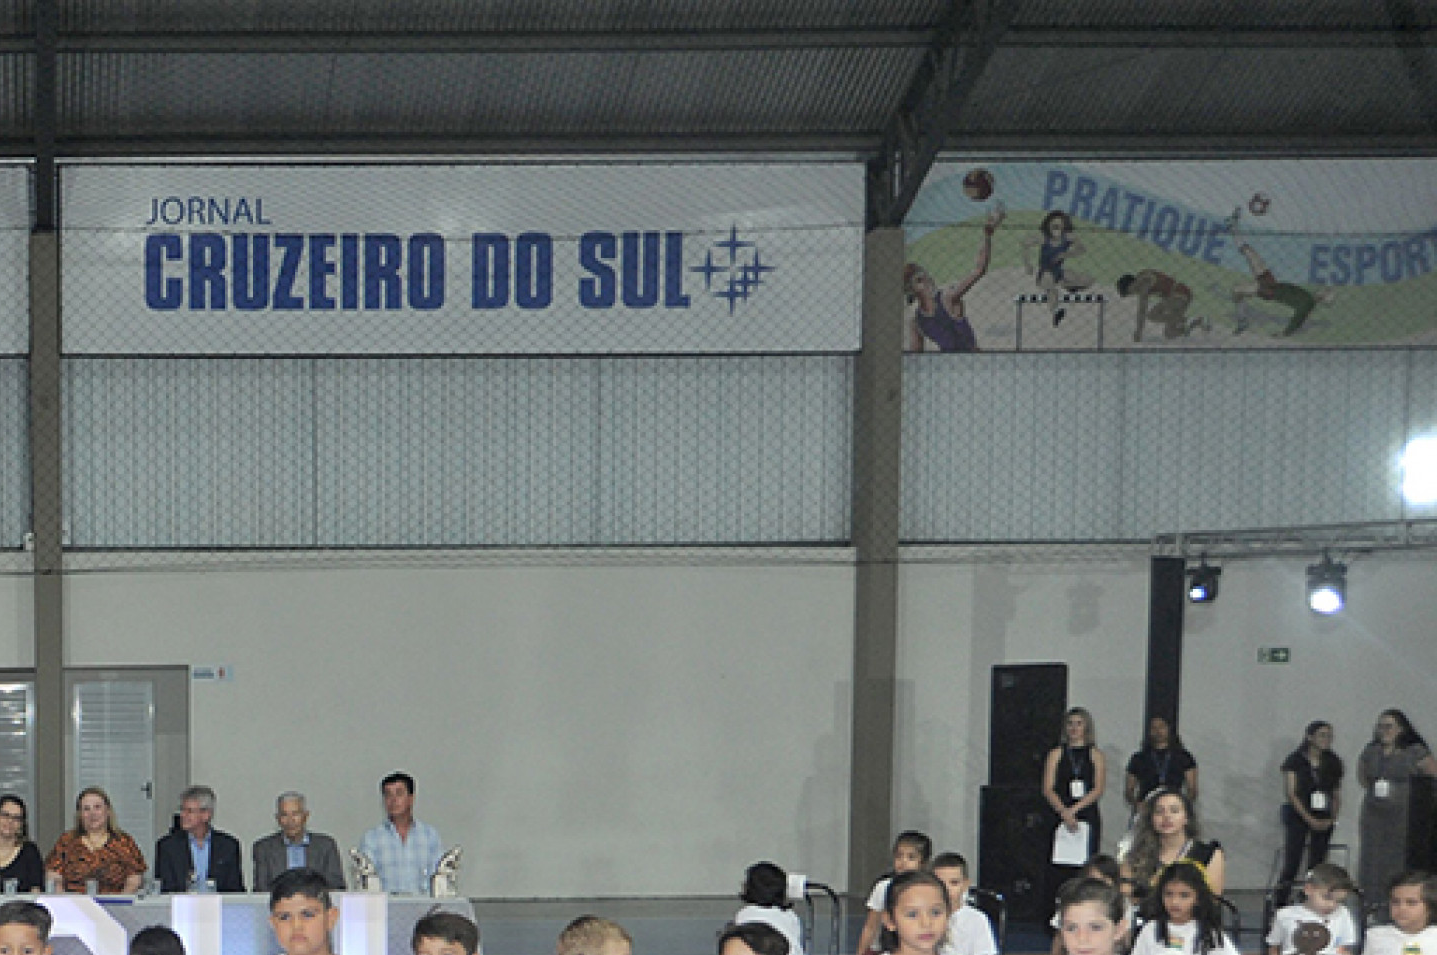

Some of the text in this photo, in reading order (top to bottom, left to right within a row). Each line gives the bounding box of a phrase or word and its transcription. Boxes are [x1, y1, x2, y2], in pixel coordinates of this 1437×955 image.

[146, 196, 273, 226] JORNAL
[1043, 170, 1437, 286] PRATIQUE ESPOR
[145, 230, 692, 311] CRUZEIRO DO SUL
